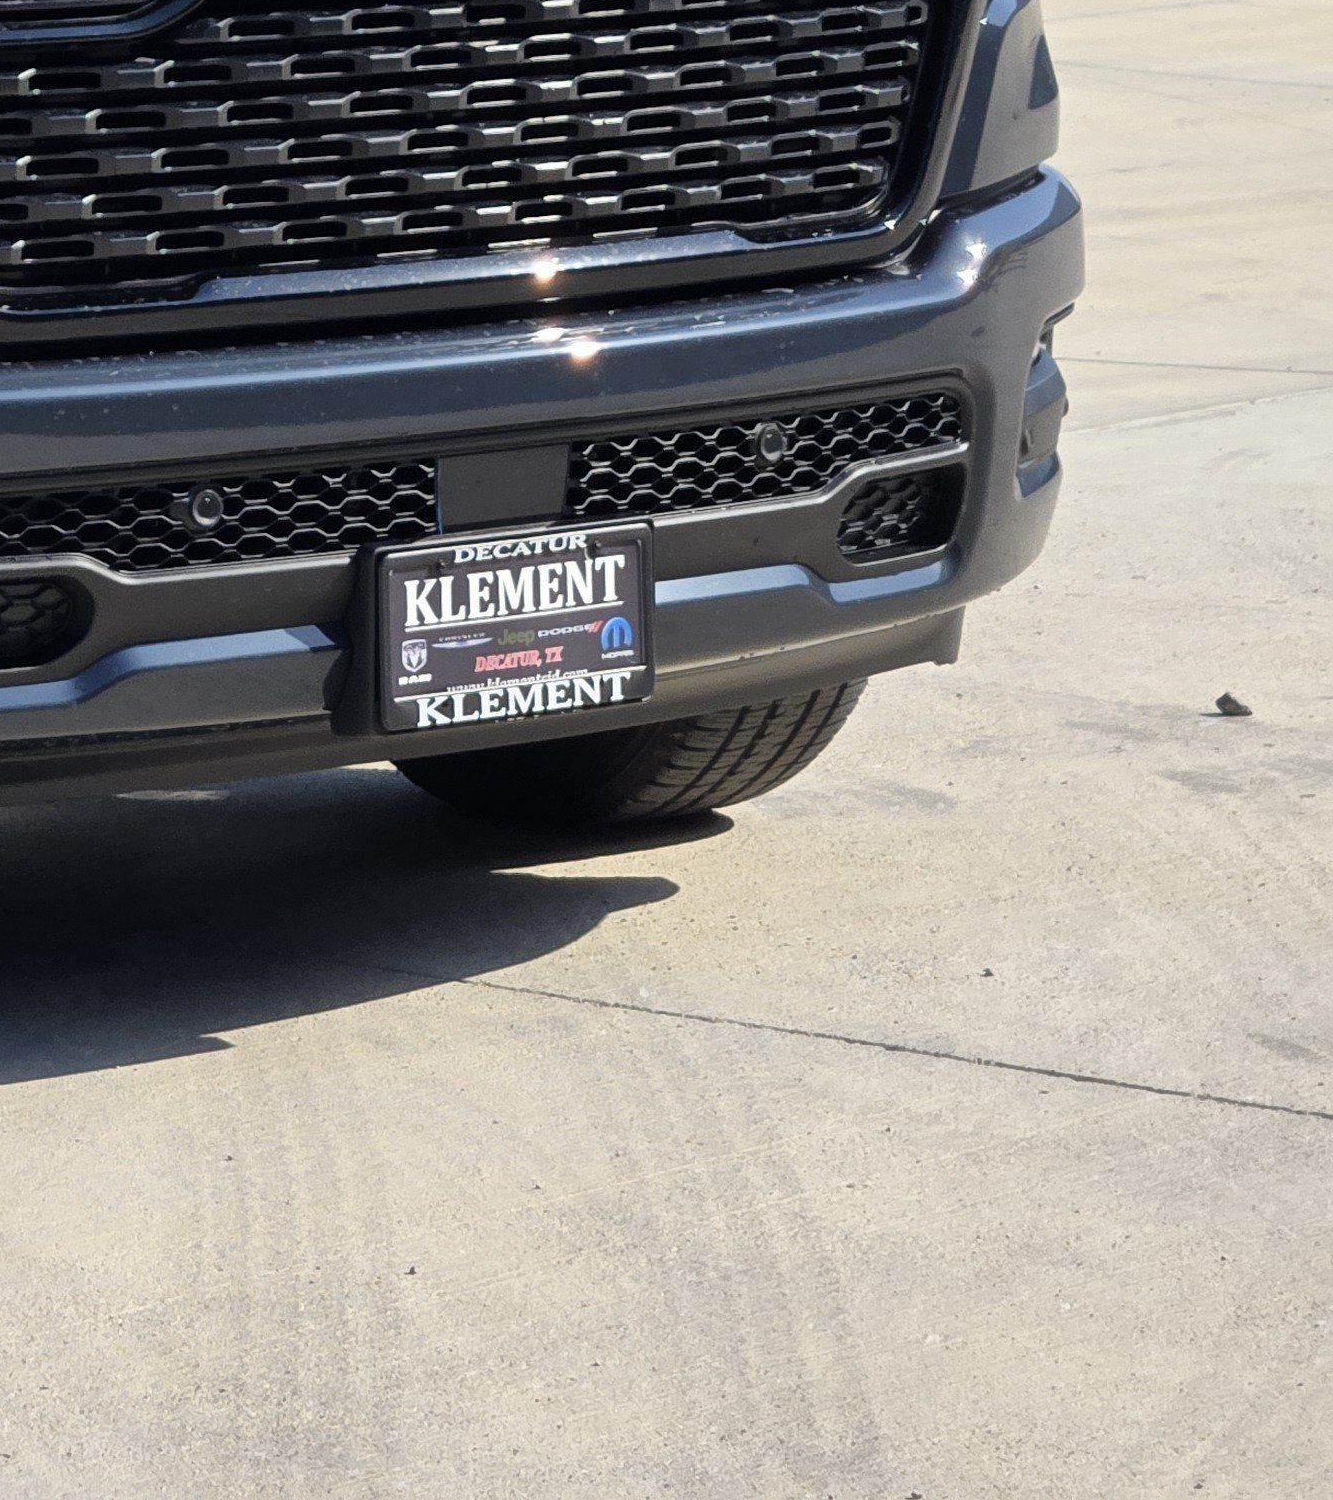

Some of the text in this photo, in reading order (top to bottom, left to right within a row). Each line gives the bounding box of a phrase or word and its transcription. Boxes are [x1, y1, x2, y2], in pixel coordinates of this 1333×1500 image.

[454, 533, 587, 564] DECATUR
[404, 554, 626, 627] KLEMENT
[497, 628, 535, 646] Jeep
[538, 624, 591, 639] DODGE
[474, 645, 565, 673] DECATUR, TX
[416, 671, 632, 729] KLEMENT
